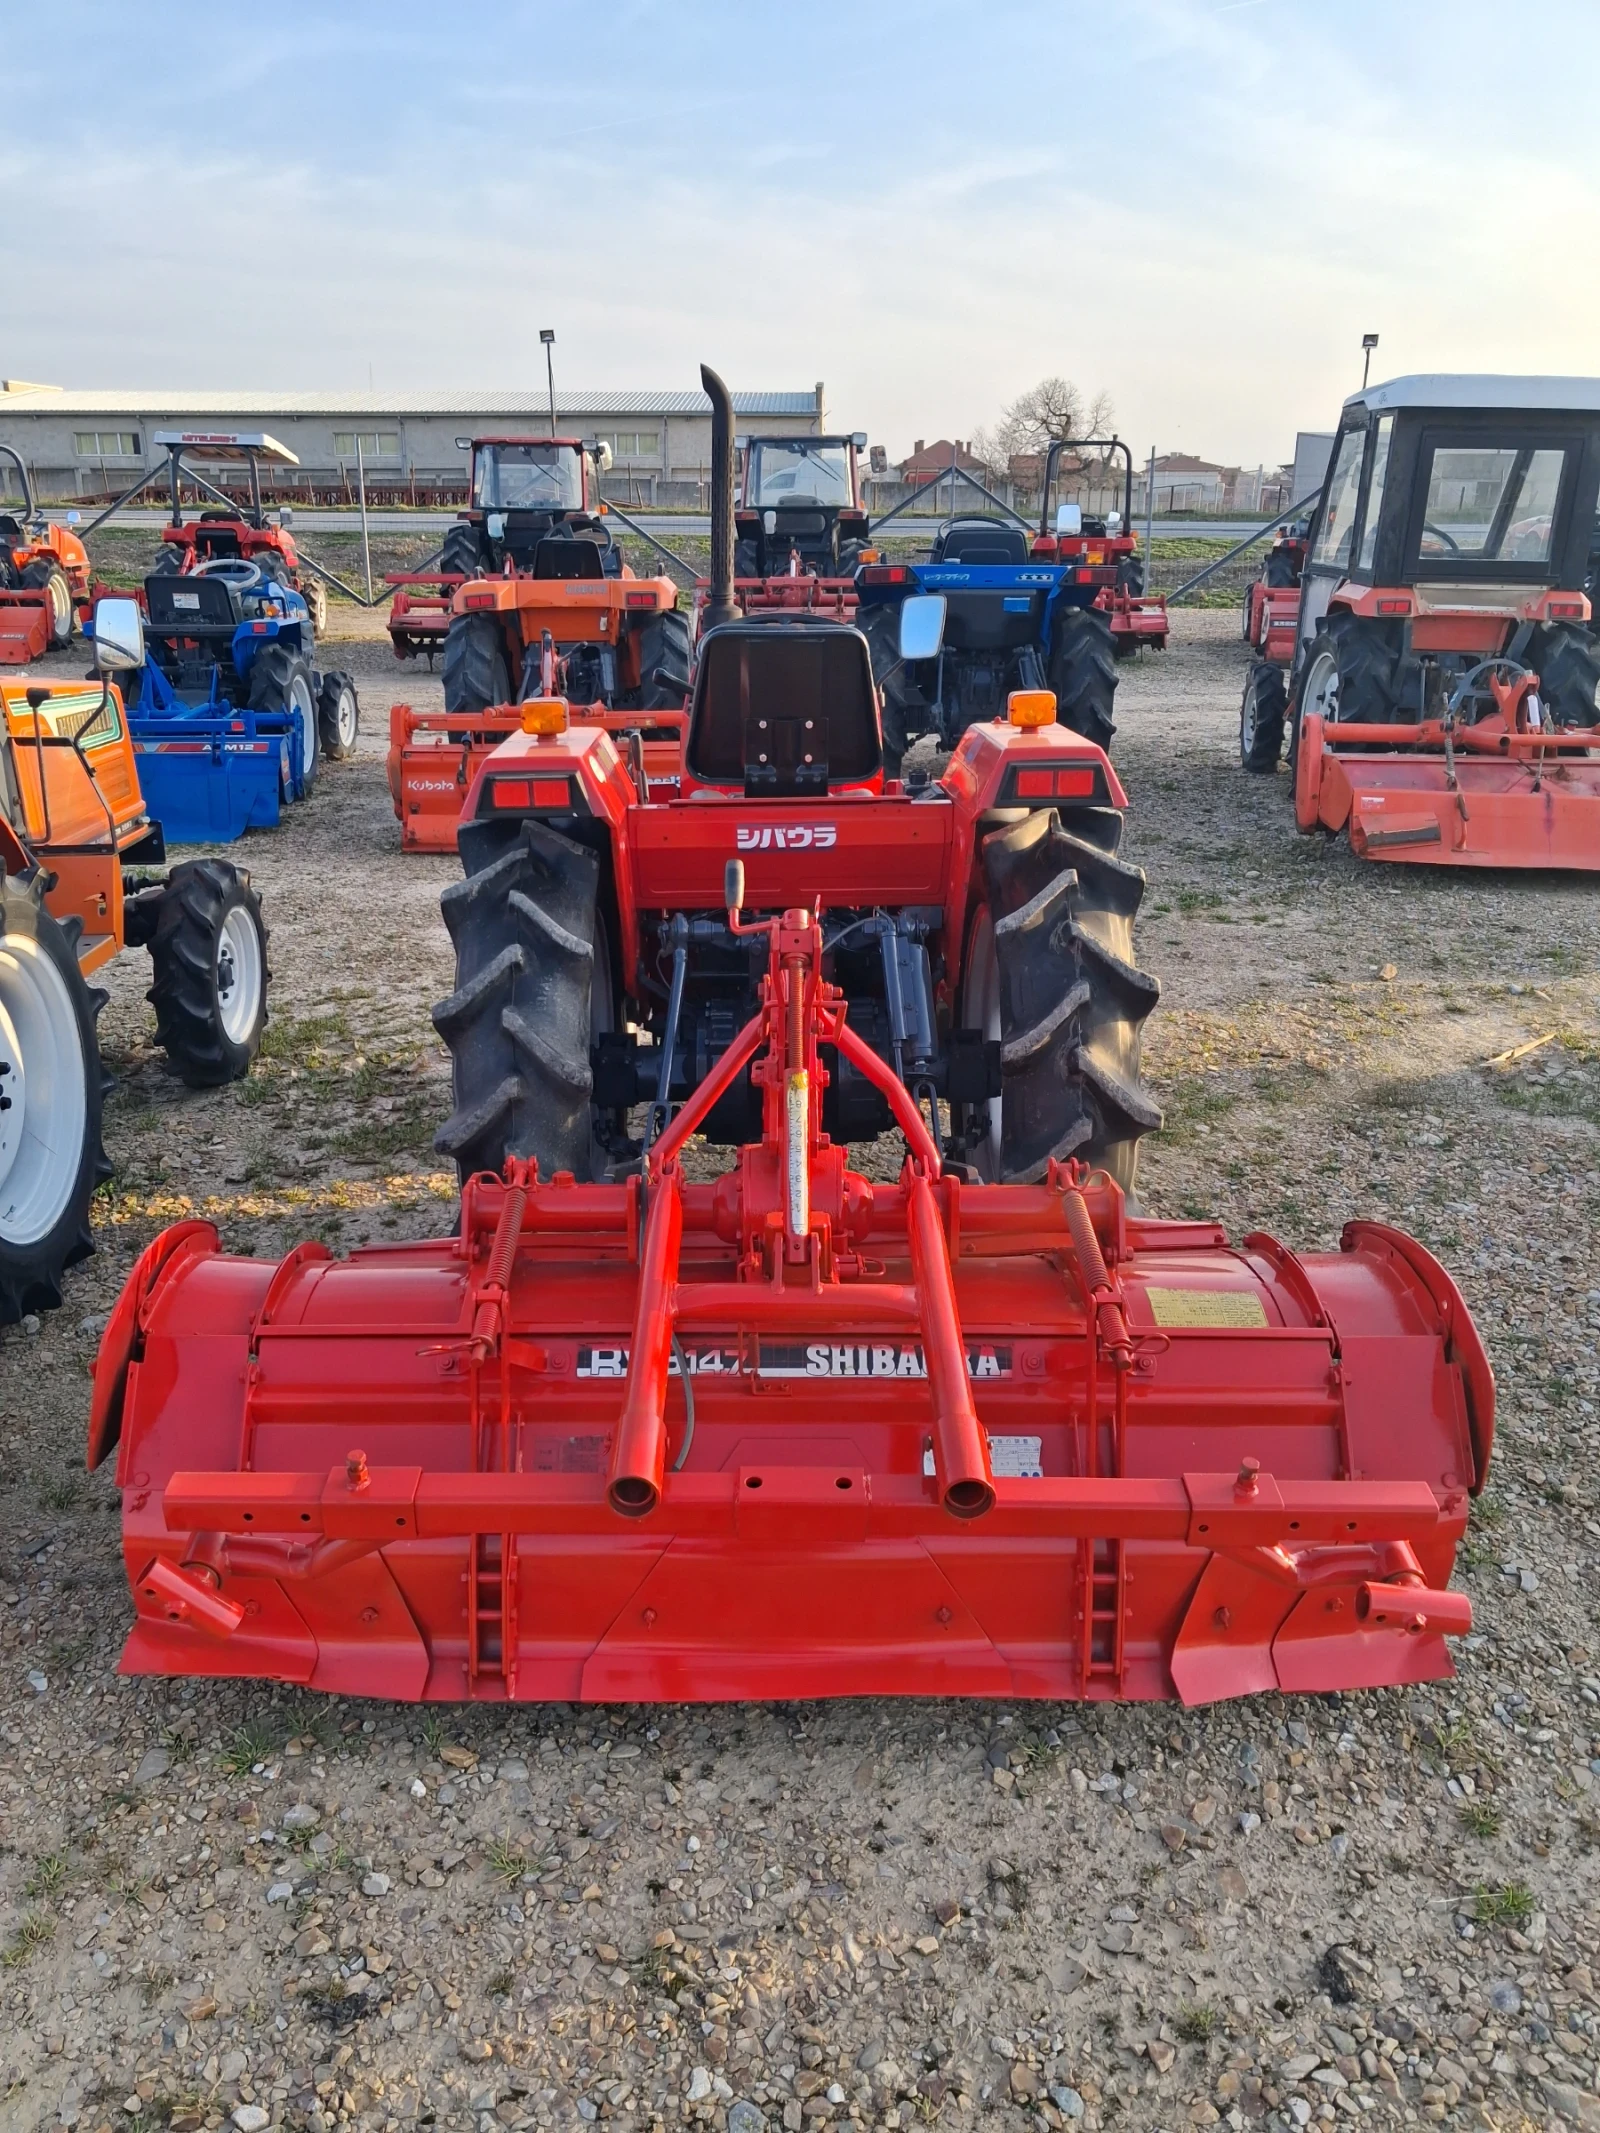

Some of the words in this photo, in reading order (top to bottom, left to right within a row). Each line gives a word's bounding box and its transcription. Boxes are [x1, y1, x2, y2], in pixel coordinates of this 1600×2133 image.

[408, 780, 455, 791] Kubota
[737, 826, 837, 849] シバウラ
[590, 1348, 748, 1376] R147
[806, 1344, 1001, 1376] SHIBAA
